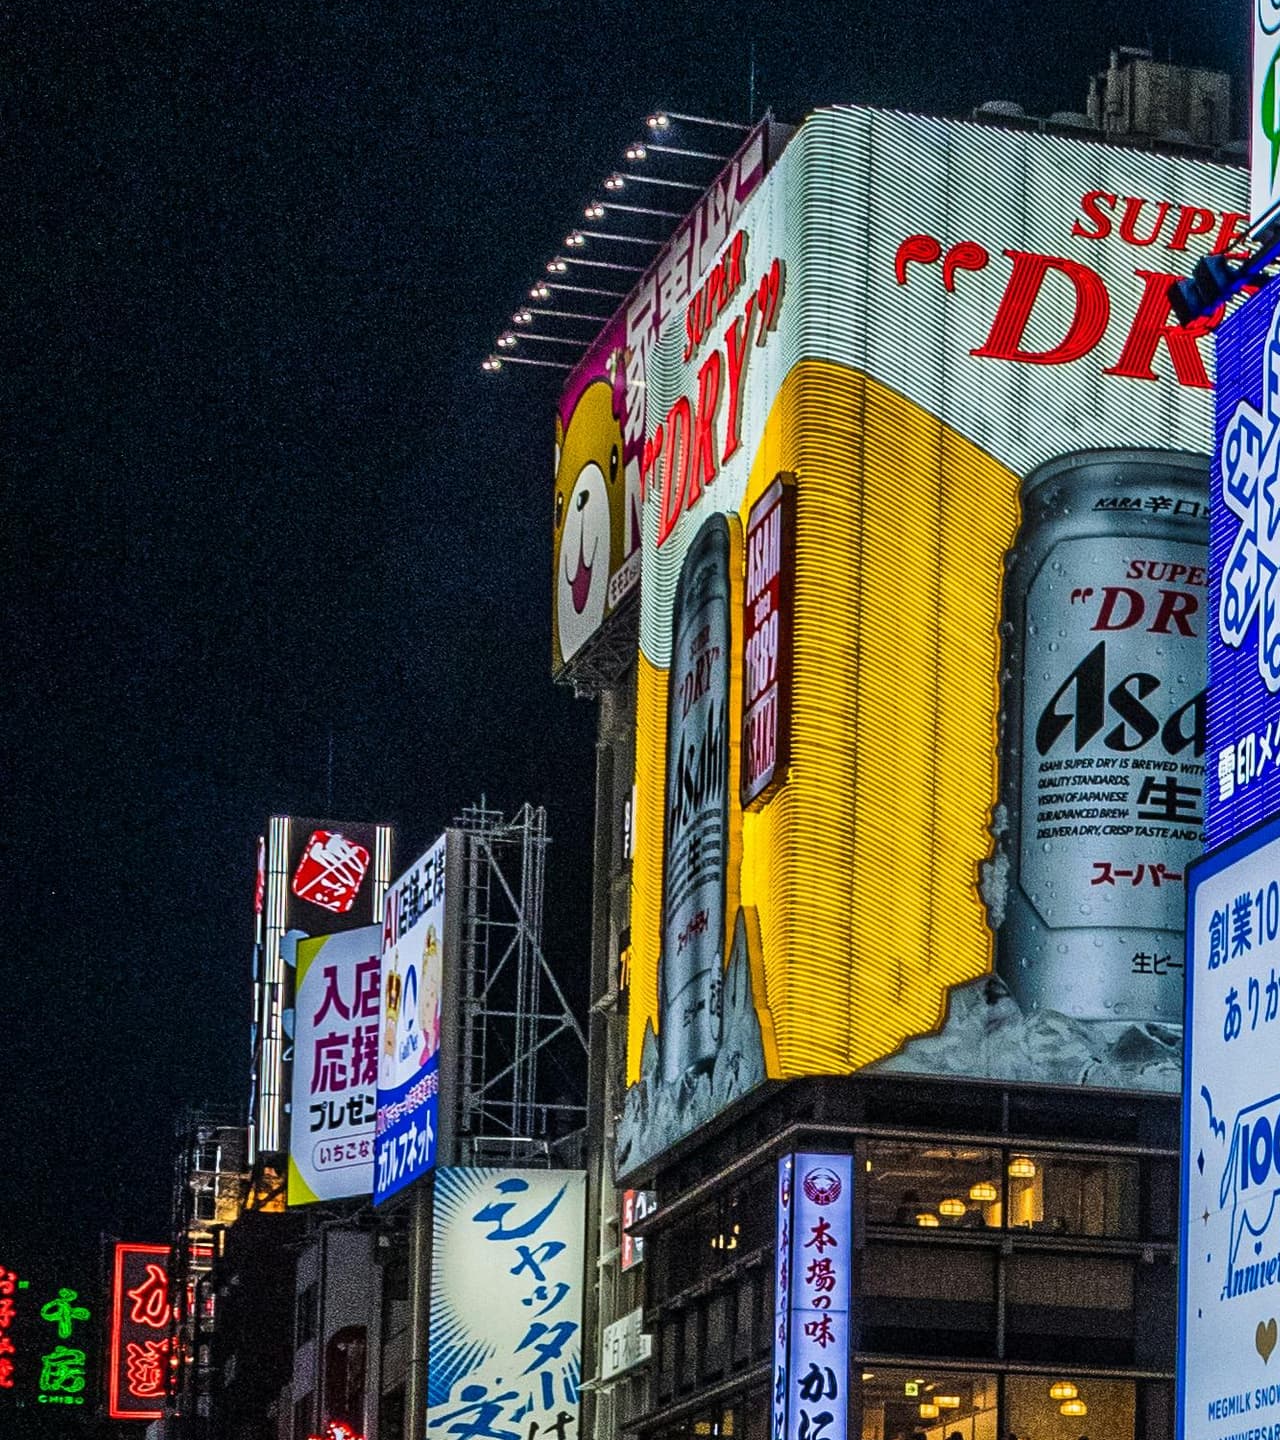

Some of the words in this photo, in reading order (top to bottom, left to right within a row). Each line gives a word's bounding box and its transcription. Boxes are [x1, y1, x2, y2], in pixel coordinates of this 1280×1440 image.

[684, 229, 748, 363] SUPER
[1144, 495, 1199, 518] 辛口
[746, 610, 778, 707] 1889
[1064, 759, 1093, 769] SUPER
[1096, 758, 1117, 768] DRY
[1119, 759, 1129, 768] IS
[1131, 759, 1178, 772] BREWED
[1038, 776, 1071, 789] QUALITY
[1071, 775, 1130, 787] STANDARDS,
[1079, 792, 1129, 803] JAPANESE
[1136, 776, 1204, 825] 生
[1079, 825, 1100, 837] DRY,
[1102, 825, 1133, 836] CRISP
[1135, 827, 1169, 839] TASTE
[1170, 829, 1197, 841] AND
[1091, 862, 1182, 888] スーパー
[377, 1110, 434, 1193] ガルフネット
[804, 1216, 838, 1349] 本場の味
[39, 1287, 91, 1392] 千房
[38, 1394, 84, 1405] CHIBO
[1208, 1391, 1251, 1422] MEGMILK
